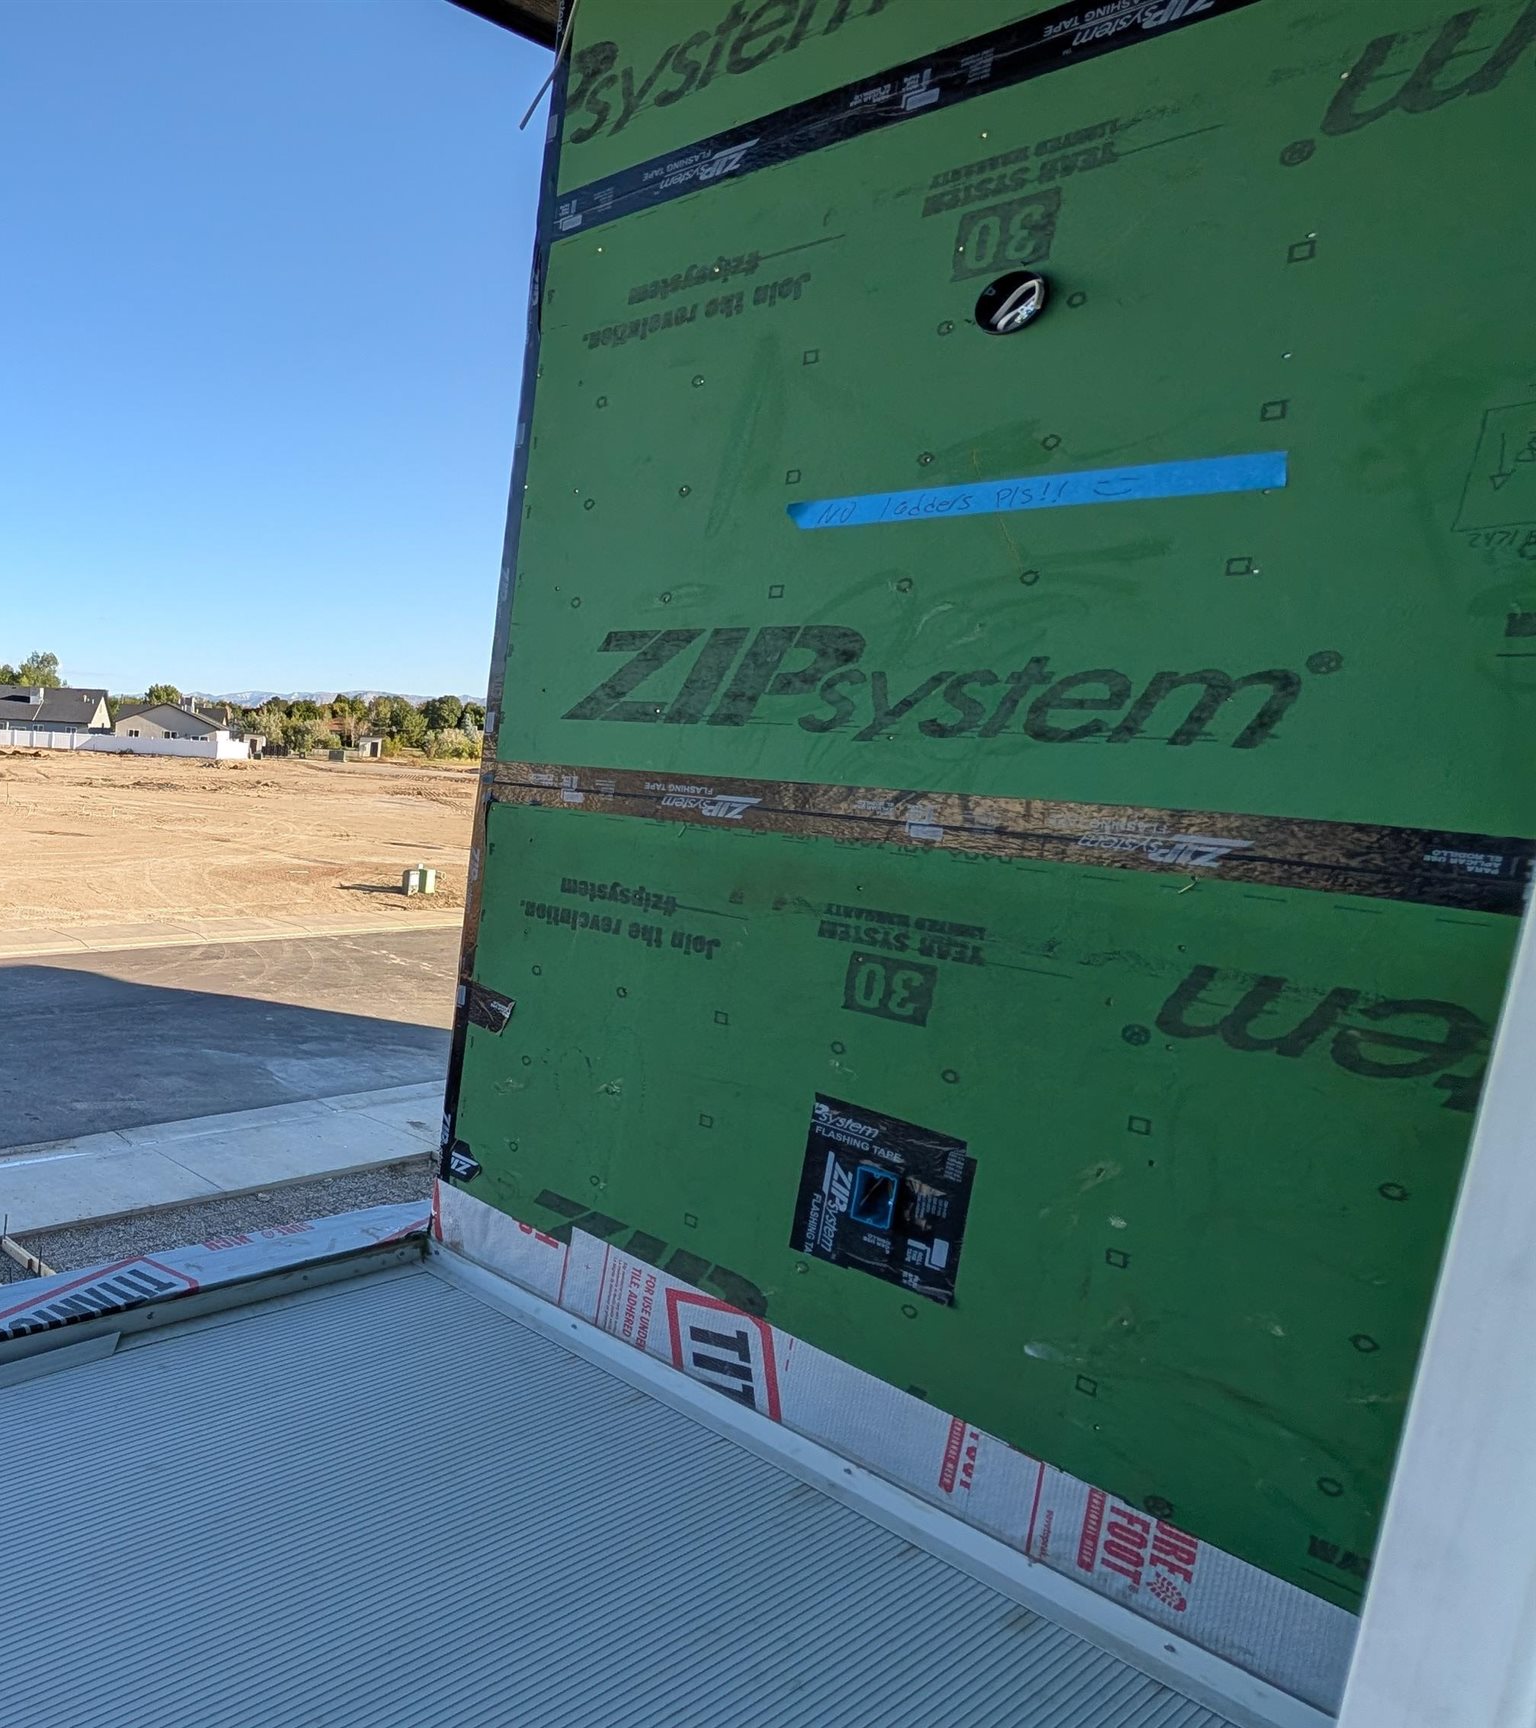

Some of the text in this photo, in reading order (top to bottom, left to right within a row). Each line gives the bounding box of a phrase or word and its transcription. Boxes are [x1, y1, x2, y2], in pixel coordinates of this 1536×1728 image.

[1043, 18, 1081, 38] TAPE
[641, 150, 712, 182] FLASHING TAPE
[660, 149, 746, 189] ZIPsystem
[964, 203, 1044, 270] 30
[880, 494, 973, 518] ladders
[560, 624, 1304, 750] ZIPsystem
[644, 781, 713, 796] FLASHING TAPE
[661, 795, 750, 819] ZIPsystem
[1077, 833, 1234, 868] ZIPsystem
[628, 921, 663, 949] the
[671, 929, 722, 960] Join
[855, 963, 924, 1016] 30
[815, 1126, 870, 1152] FLASHING
[806, 1192, 822, 1239] FLASHING
[821, 1160, 853, 1252] ZIPsystem
[644, 1273, 657, 1296] FOR
[623, 1289, 638, 1338] ADHERED
[641, 1295, 654, 1315] USE
[1100, 1505, 1151, 1586] FOOT
